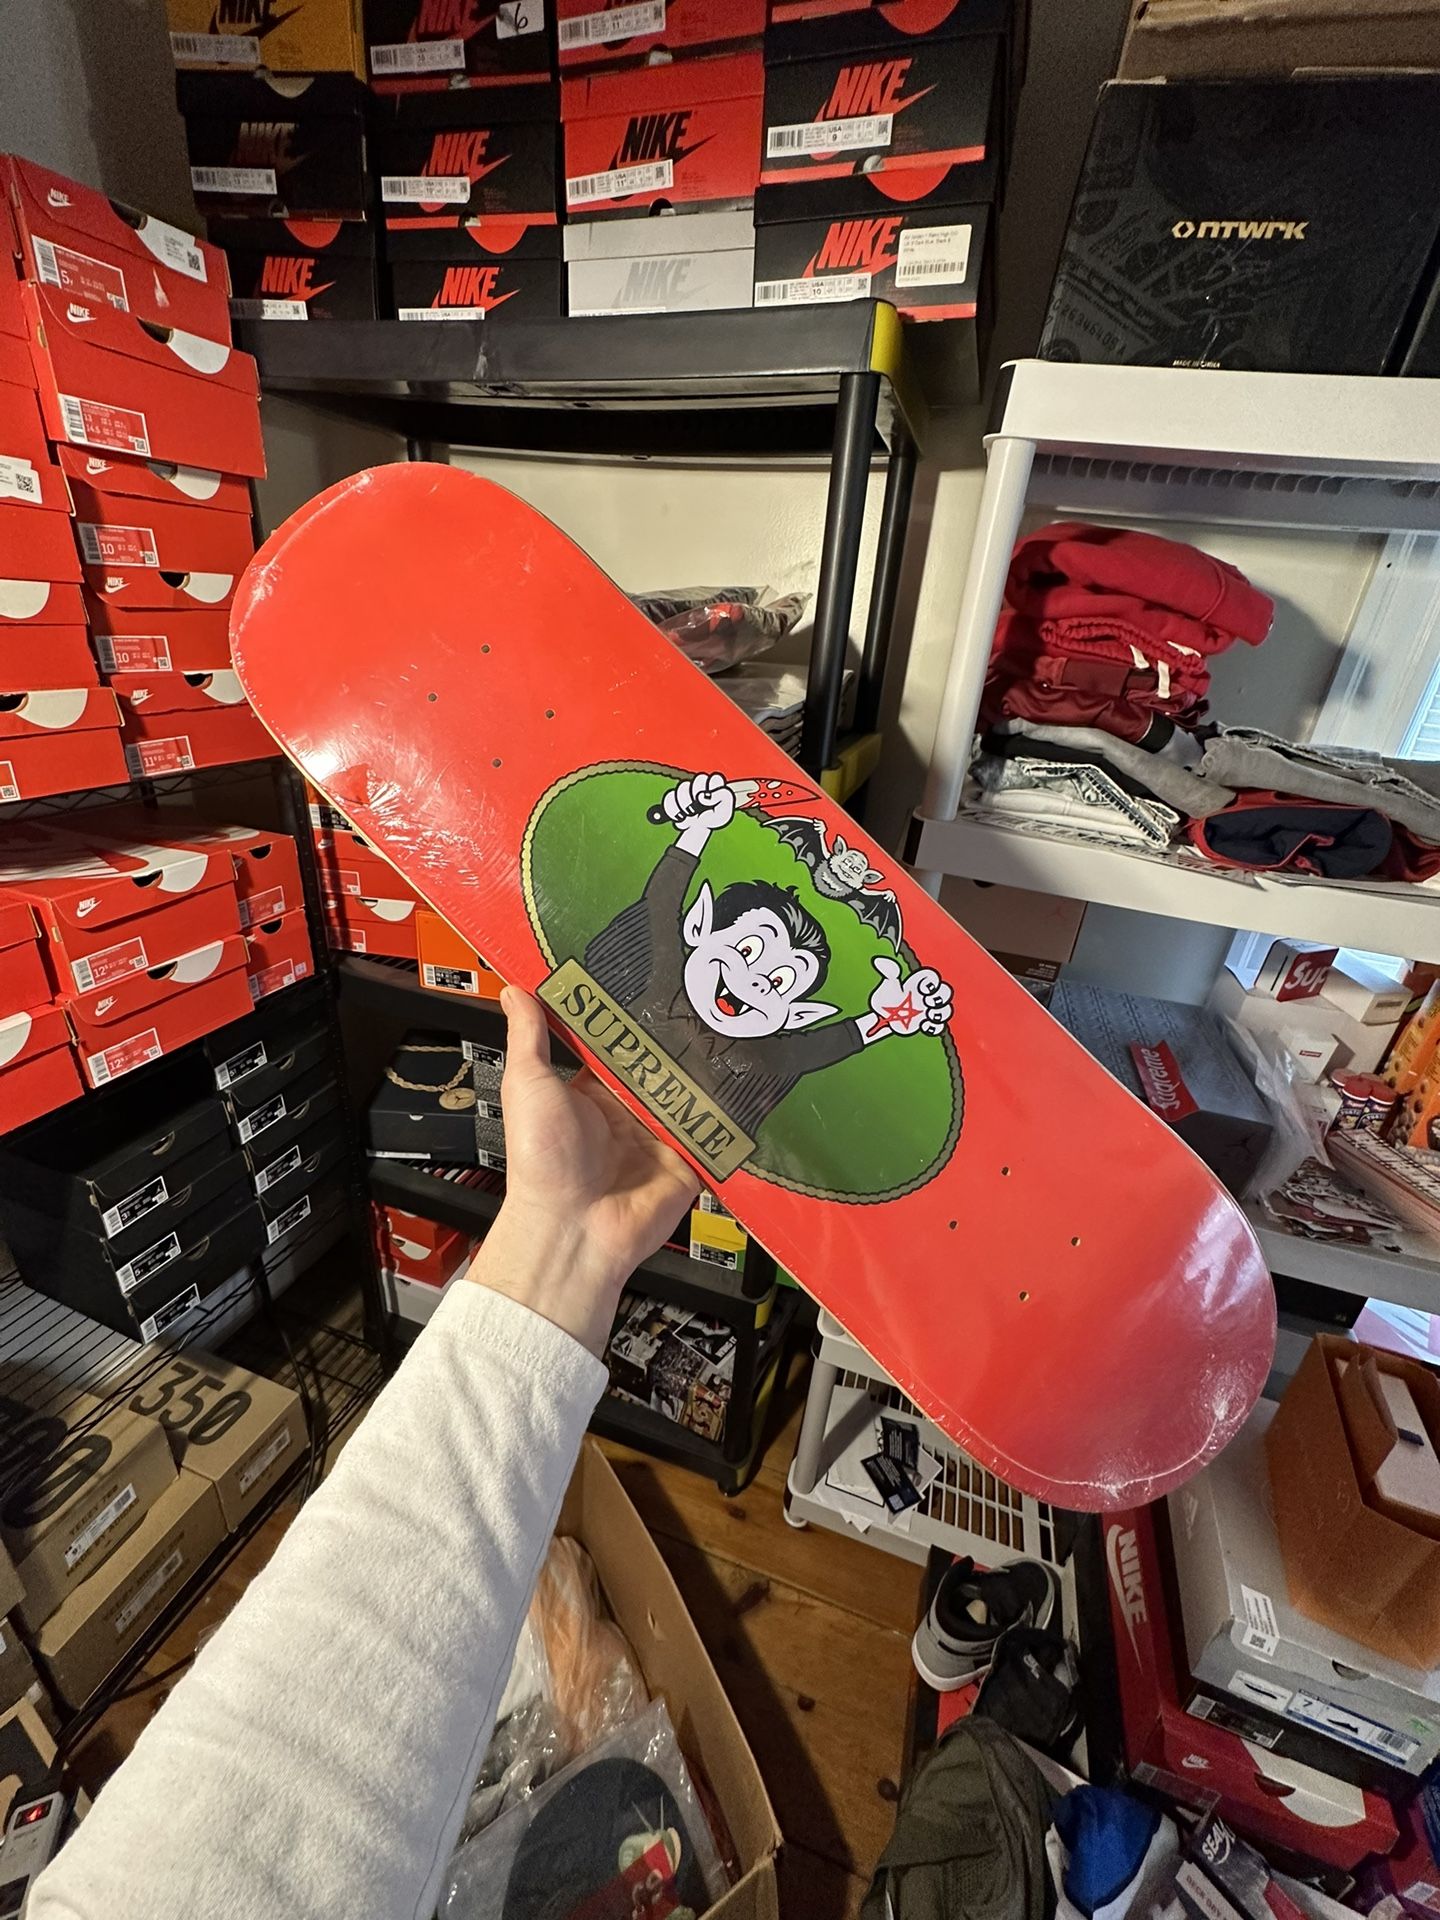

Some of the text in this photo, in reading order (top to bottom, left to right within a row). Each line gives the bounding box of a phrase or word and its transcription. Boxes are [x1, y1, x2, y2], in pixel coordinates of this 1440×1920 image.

[513, 3, 529, 29] 6
[826, 58, 912, 119] NIKE
[619, 110, 693, 163] NIKE
[828, 125, 842, 133] USA
[428, 131, 490, 175] NIKE
[50, 188, 69, 203] NIKE
[816, 217, 903, 269] NIKE
[262, 256, 315, 293] NIKE
[622, 258, 692, 301] NIKE
[440, 267, 500, 305] NIKE
[811, 281, 825, 289] USA
[812, 288, 822, 296] 10
[69, 302, 90, 320] NIKE
[89, 457, 106, 469] NIKE
[101, 543, 115, 555] 10
[107, 576, 124, 587] NIKE
[116, 652, 130, 663] 10
[132, 688, 148, 700] NIKE
[79, 897, 96, 911] NIKE
[98, 996, 115, 1010] NIKE
[560, 983, 736, 1160] SUPREME
[1141, 1048, 1181, 1110] Supreme
[129, 1361, 252, 1446] 350
[1118, 1529, 1148, 1624] NIKE
[1188, 1754, 1210, 1767] NIKE
